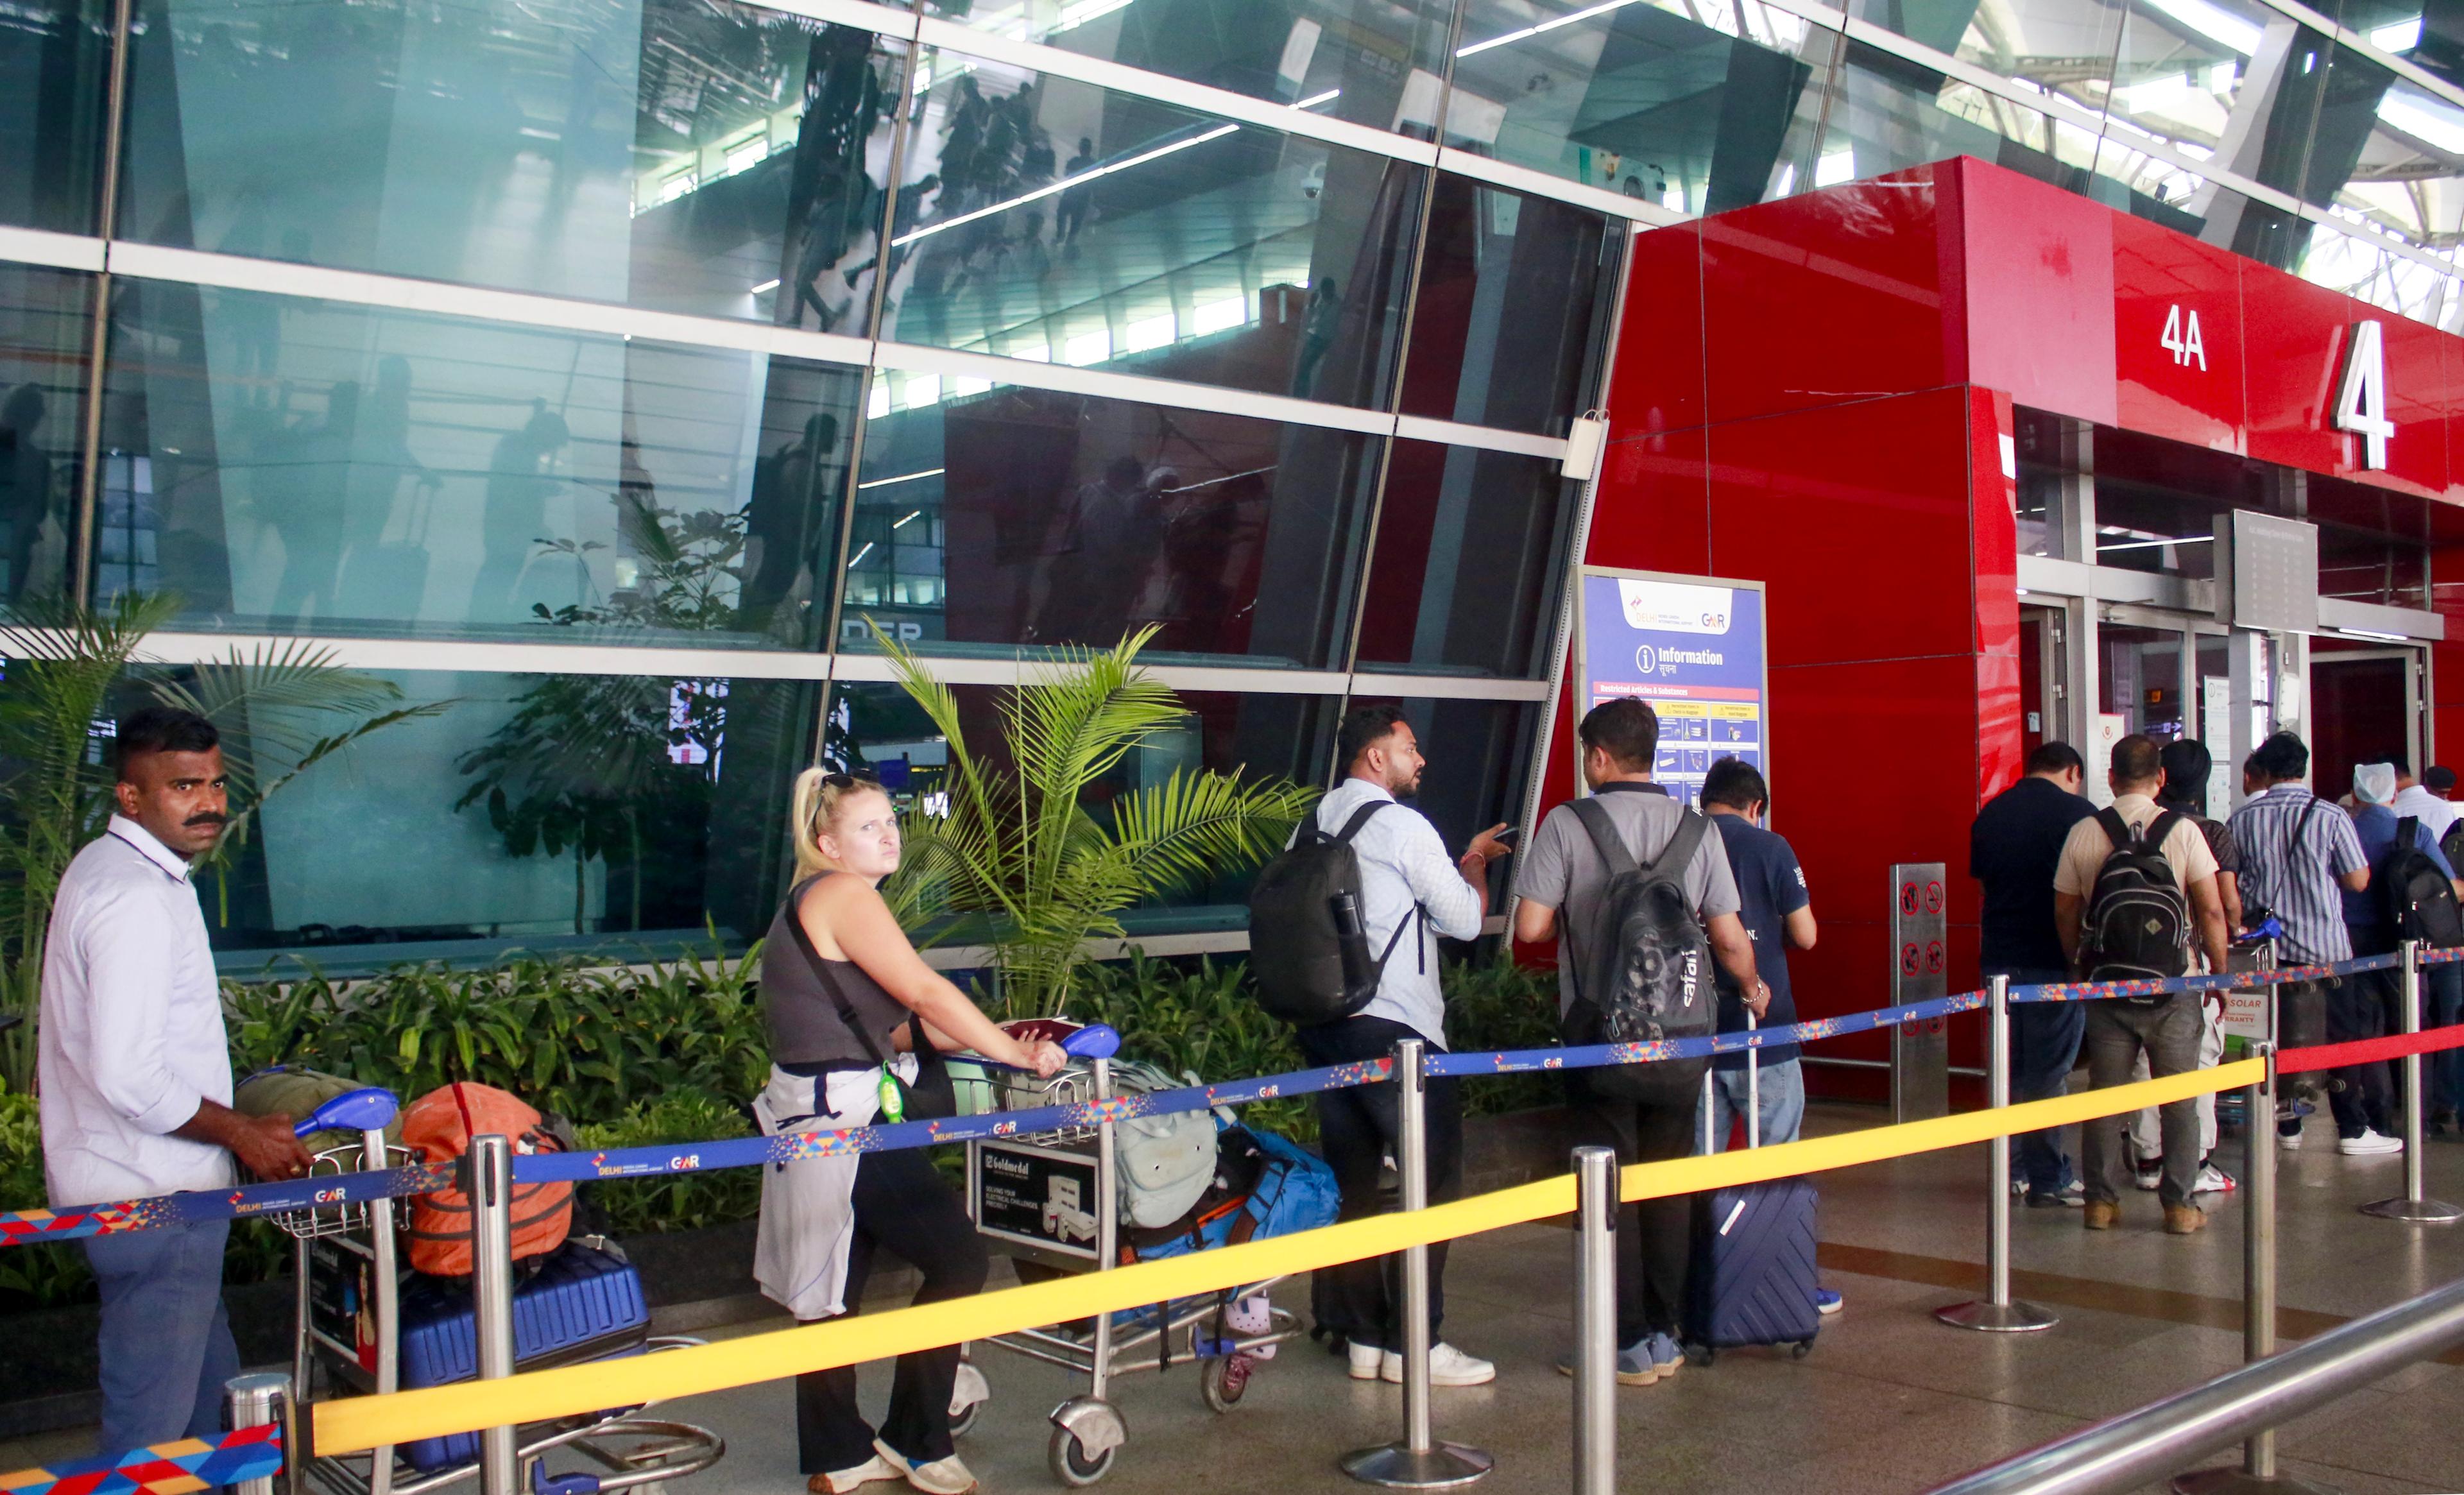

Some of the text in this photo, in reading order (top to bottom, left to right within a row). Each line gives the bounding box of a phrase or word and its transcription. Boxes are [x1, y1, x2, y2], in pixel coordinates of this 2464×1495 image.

[2160, 303, 2207, 372] 4A
[2334, 320, 2395, 471] 4
[1659, 647, 1723, 665] Information
[1659, 664, 1677, 677] सूचना
[1600, 685, 1630, 694] Restricted
[1630, 686, 1652, 694] Articles
[1658, 687, 1688, 696] Substances
[1681, 950, 1697, 1007] safari
[599, 1166, 622, 1176] DELHI
[993, 1156, 1029, 1175] Goldmedal
[236, 1202, 261, 1213] DELHI
[1011, 1198, 1038, 1210] CHALLENGES
